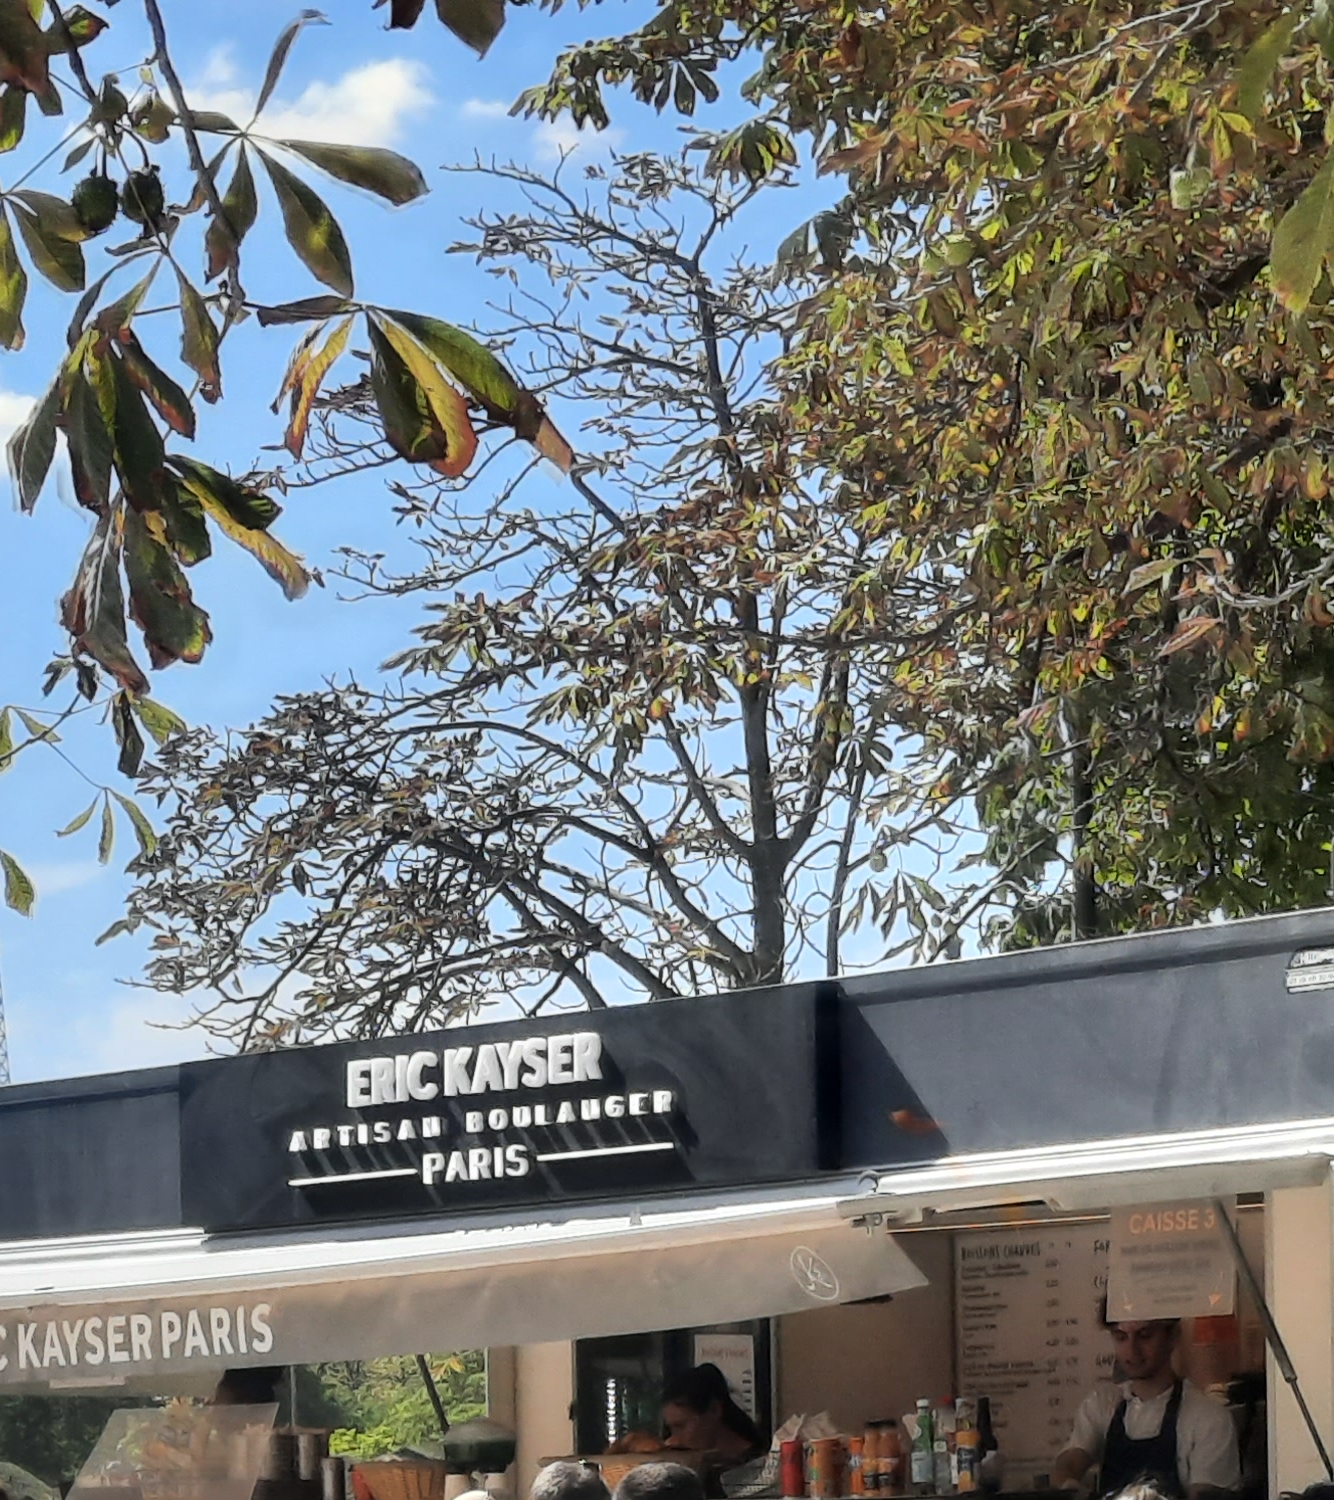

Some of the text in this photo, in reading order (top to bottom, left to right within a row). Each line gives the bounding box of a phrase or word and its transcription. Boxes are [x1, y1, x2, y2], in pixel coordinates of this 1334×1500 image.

[347, 1032, 603, 1108] ERIC KAYSER
[288, 1090, 673, 1152] ARTISAN BOULANGER
[422, 1144, 530, 1186] PARIS
[1129, 1210, 1216, 1235] CAISSE 3
[18, 1314, 152, 1370] KAYSER
[161, 1303, 273, 1359] PARIS
